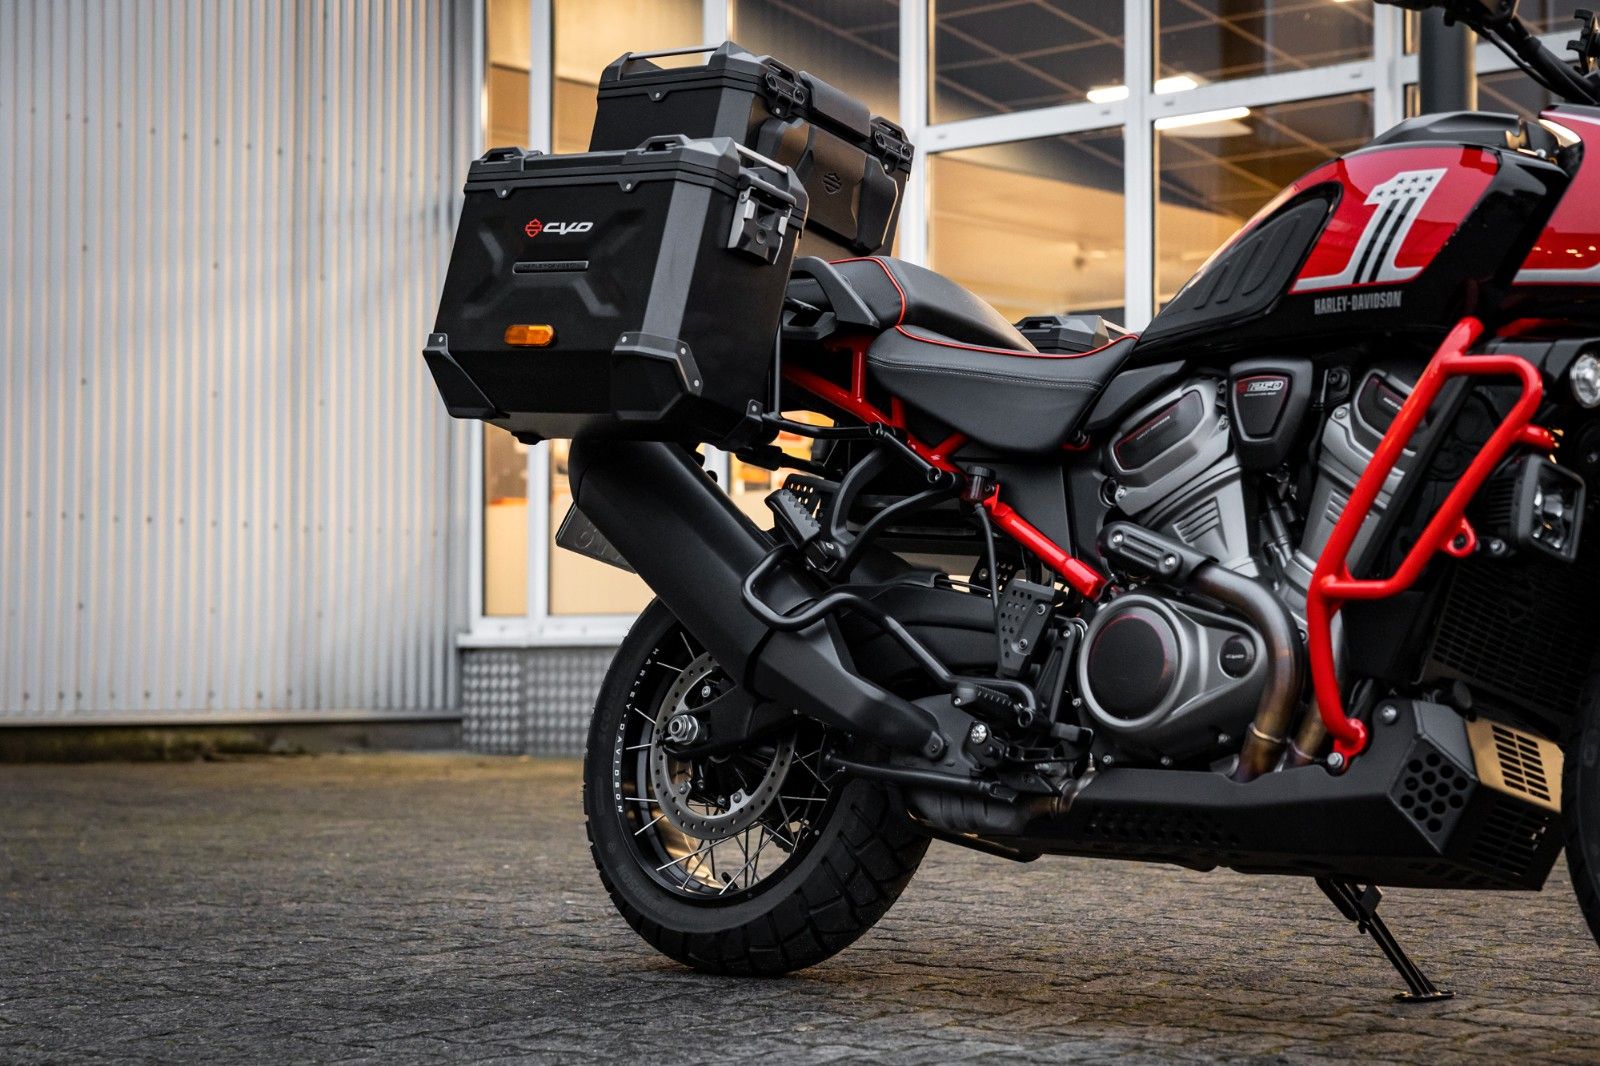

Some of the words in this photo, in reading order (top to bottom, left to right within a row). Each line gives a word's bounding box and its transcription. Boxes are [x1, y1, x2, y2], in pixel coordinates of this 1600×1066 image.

[543, 222, 593, 234] CVO
[1314, 291, 1402, 315] HARLEY-DAVIDSON
[614, 648, 659, 813] HARLEY-DAVIDSON
